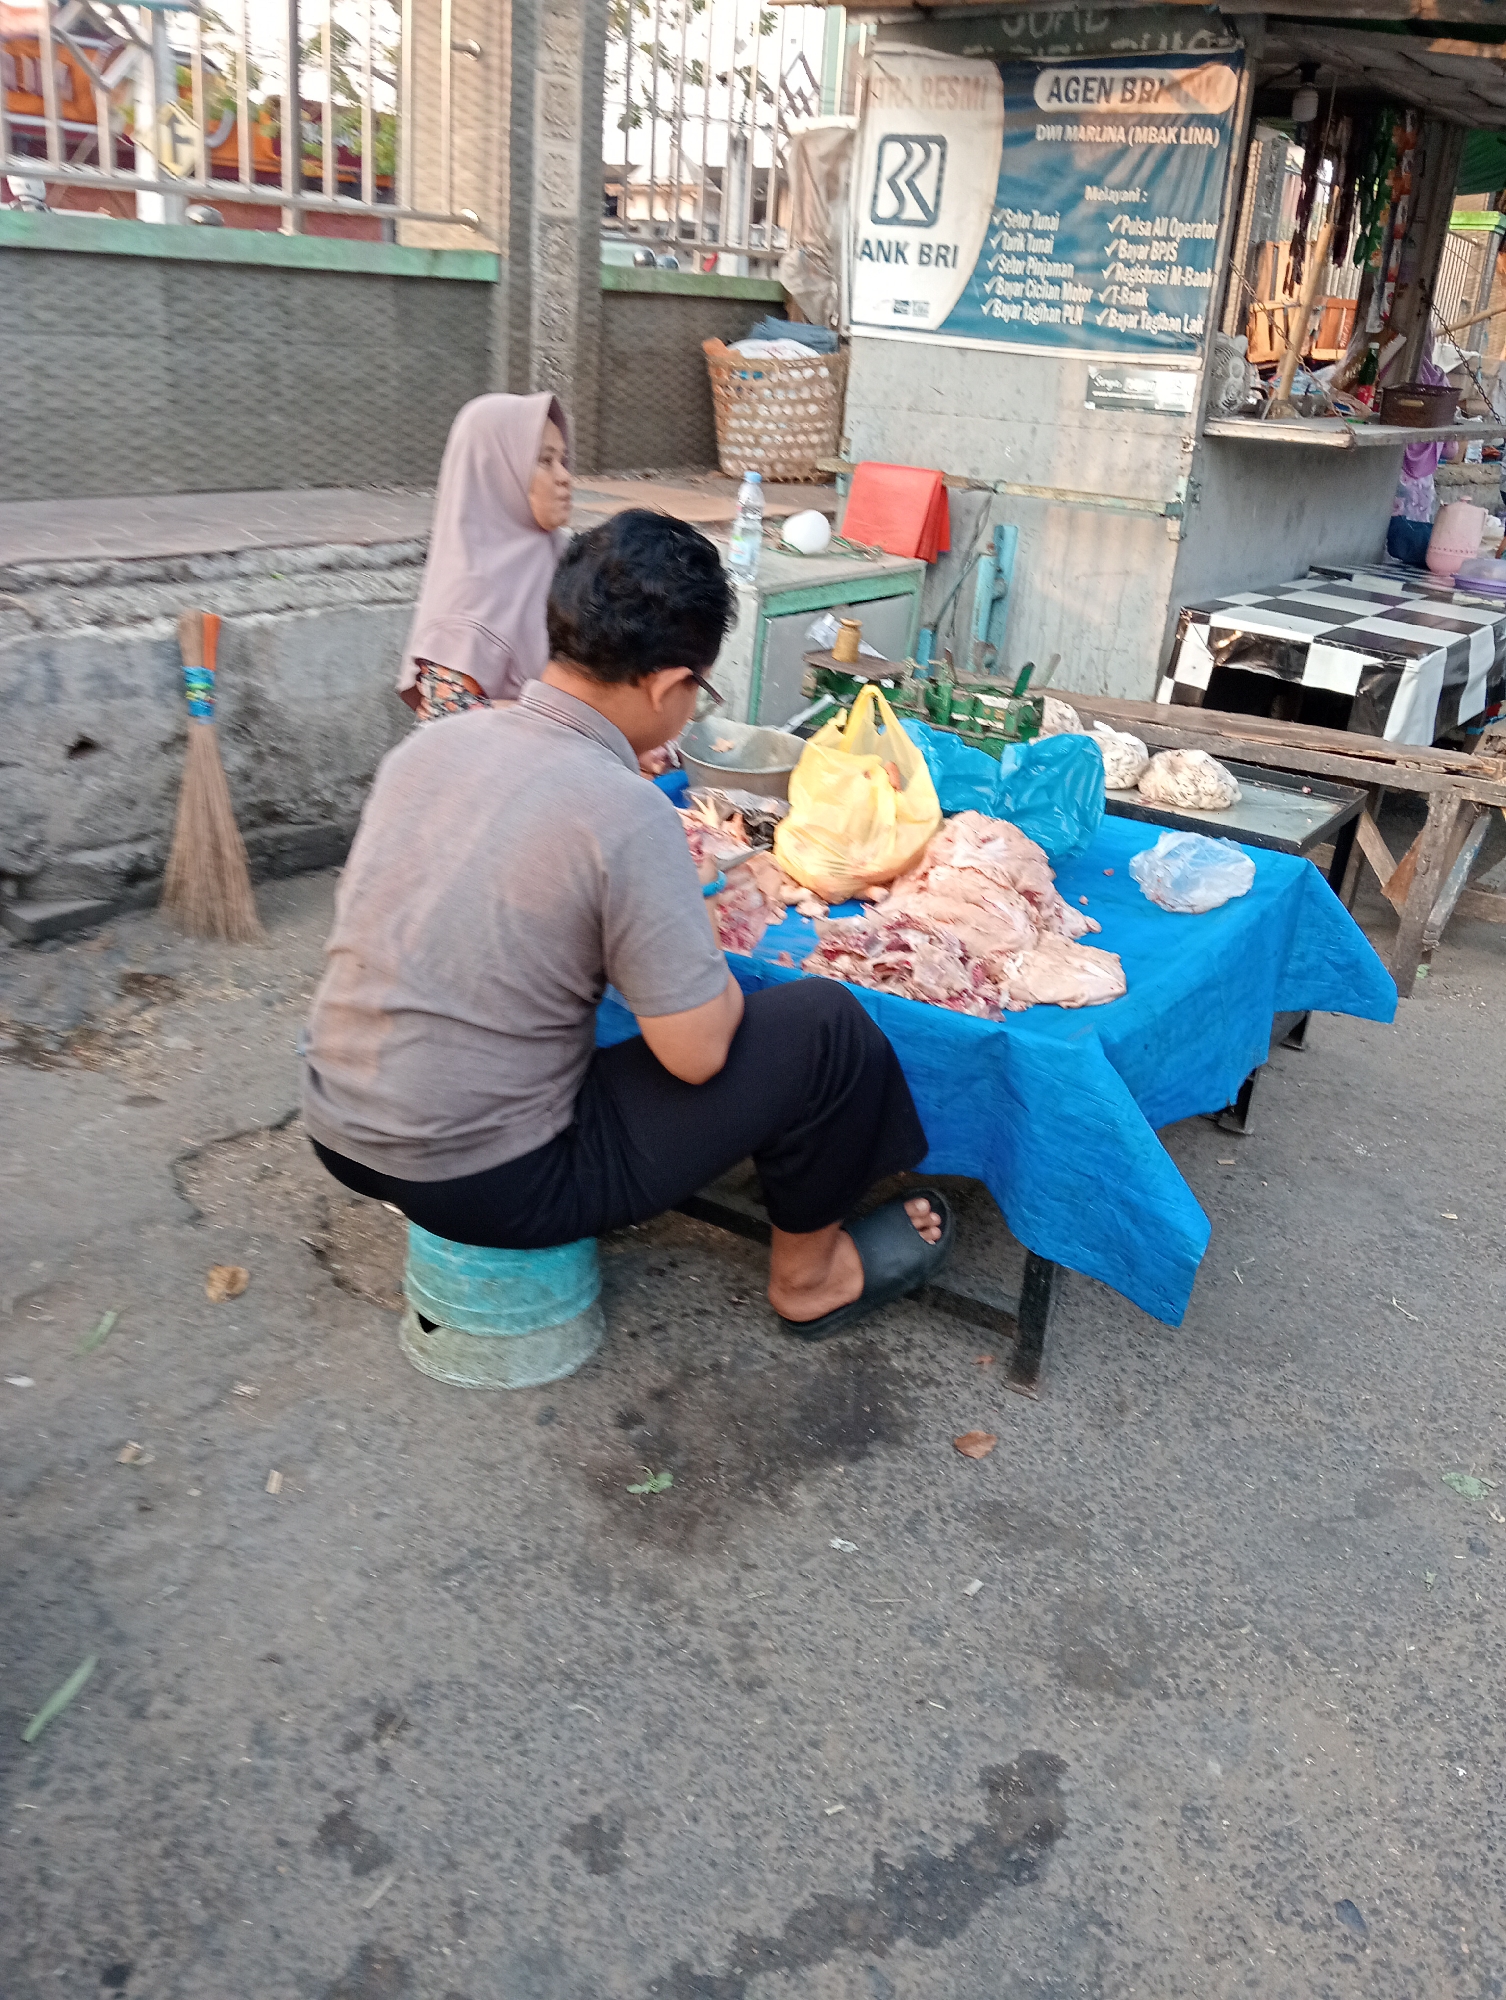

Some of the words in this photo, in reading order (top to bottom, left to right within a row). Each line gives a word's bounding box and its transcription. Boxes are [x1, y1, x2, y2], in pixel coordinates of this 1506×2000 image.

[921, 76, 987, 111] RESMI
[1047, 76, 1114, 105] AGEN
[1036, 124, 1063, 141] DWI
[1064, 125, 1126, 144] MARLINA
[1128, 126, 1178, 147] (MBAK
[1180, 127, 1220, 149] LINA)
[1032, 209, 1060, 231] Tunai
[1120, 214, 1152, 236] Pulsa
[1169, 216, 1218, 242] Operator
[856, 238, 909, 265] ANK
[917, 243, 959, 269] BRI
[1026, 232, 1054, 254] Tunai
[1118, 238, 1149, 264] Bayar
[1150, 240, 1178, 262] BPJS
[1062, 303, 1084, 326] PLN
